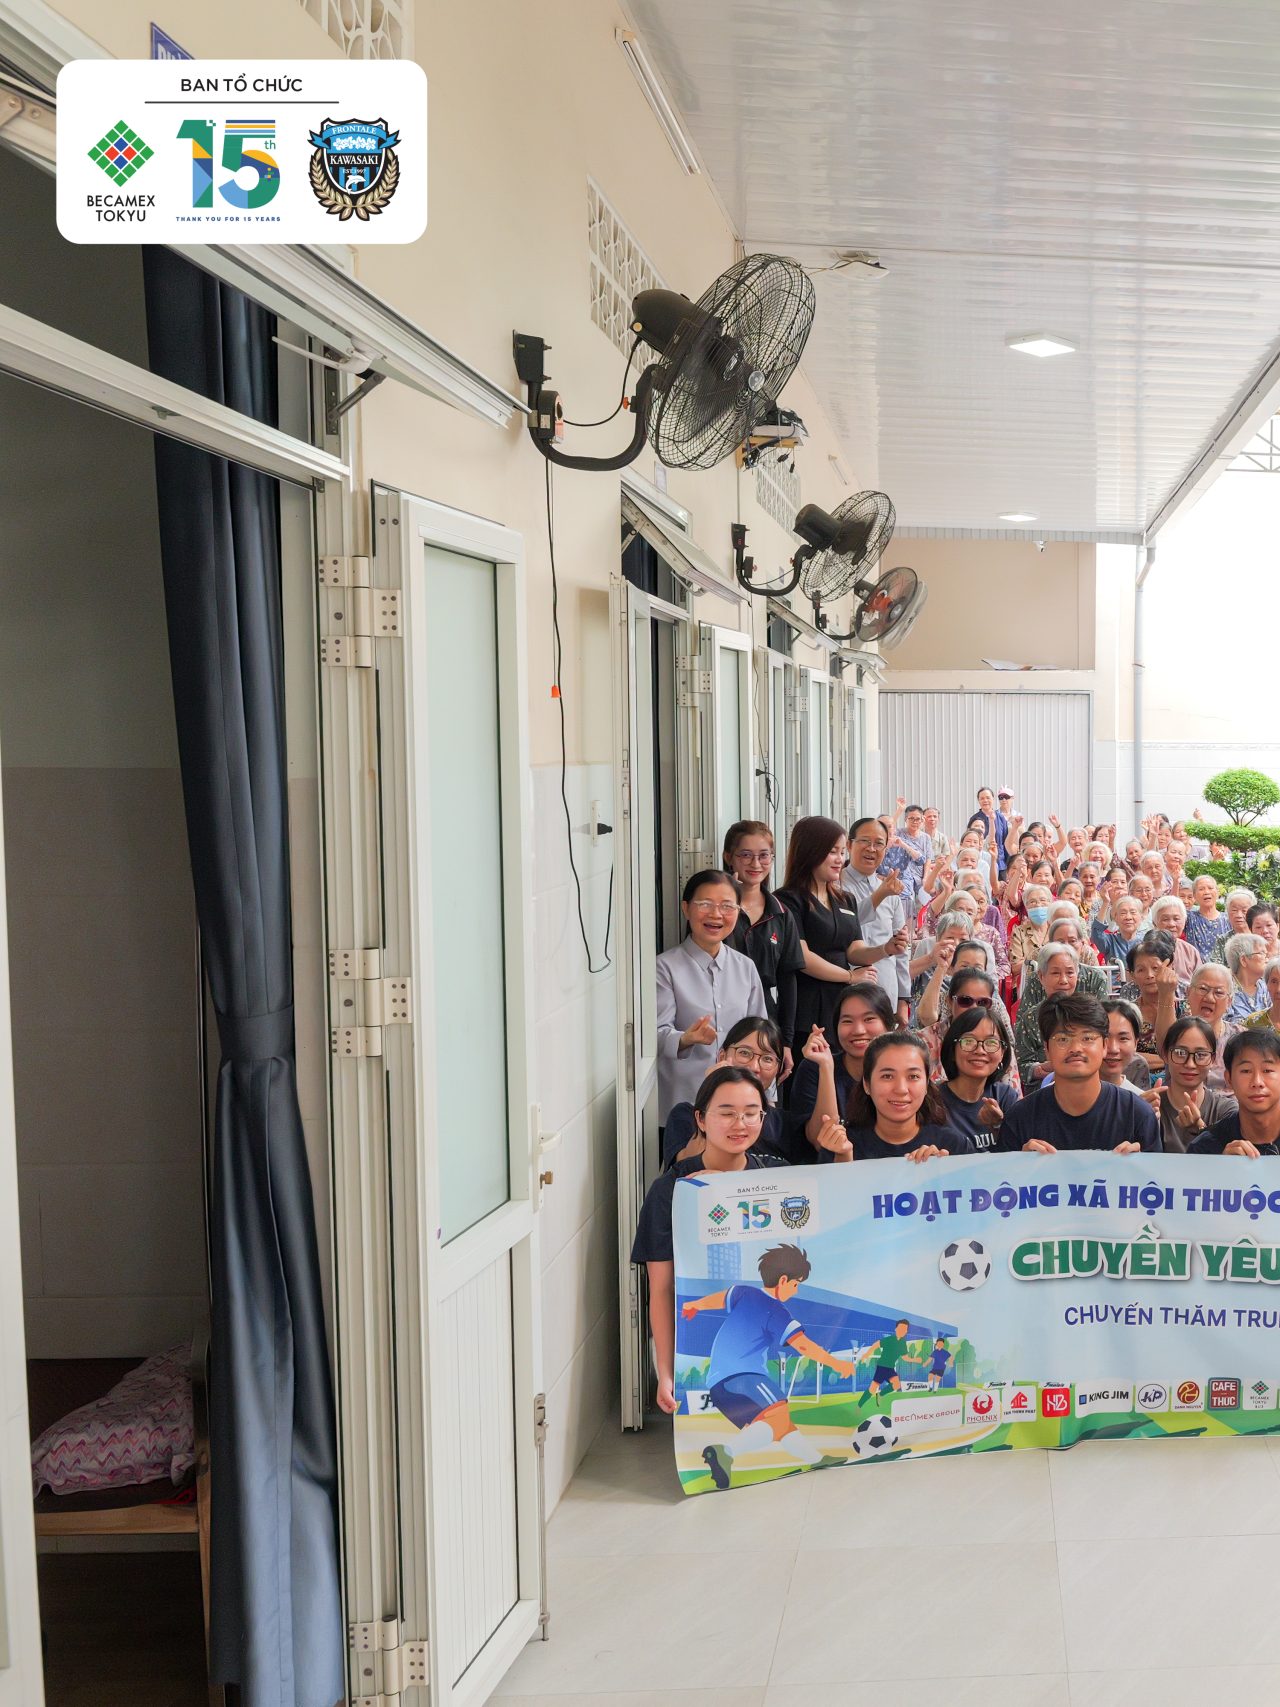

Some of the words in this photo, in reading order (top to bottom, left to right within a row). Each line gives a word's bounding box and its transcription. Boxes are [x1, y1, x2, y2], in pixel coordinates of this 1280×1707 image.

[872, 1189, 961, 1222] HOẠT
[969, 1181, 1059, 1218] ĐỘNG
[1068, 1179, 1110, 1208] XÃ
[1118, 1181, 1175, 1216] HỘI
[1012, 1224, 1188, 1277] CHUYỀN
[1064, 1302, 1153, 1327] CHUYẾN
[1160, 1304, 1227, 1328] THĂM
[1212, 1381, 1236, 1391] CAFE
[1089, 1392, 1109, 1402] KING
[1111, 1390, 1129, 1400] JIM
[1212, 1396, 1236, 1406] THUC
[936, 1409, 960, 1418] GROUP
[967, 1414, 998, 1422] PHOENIX
